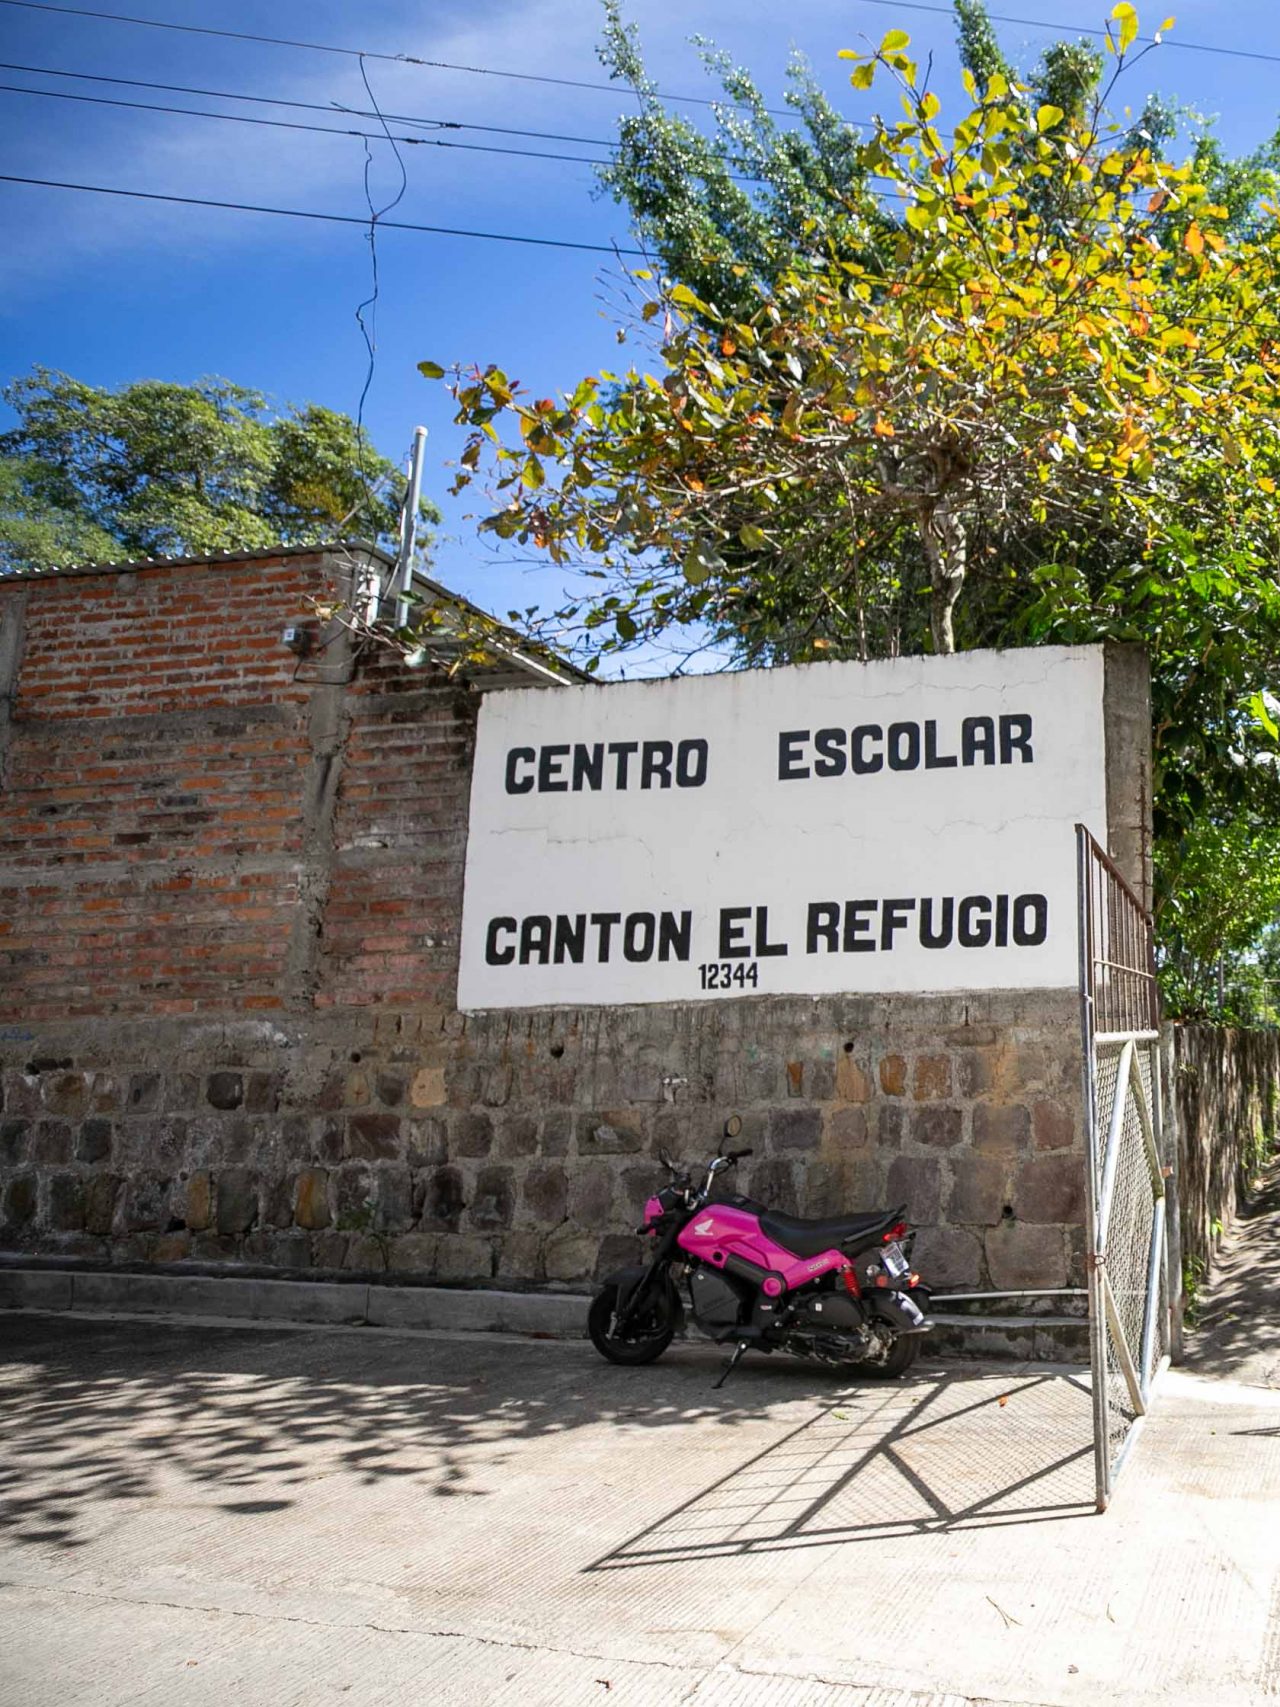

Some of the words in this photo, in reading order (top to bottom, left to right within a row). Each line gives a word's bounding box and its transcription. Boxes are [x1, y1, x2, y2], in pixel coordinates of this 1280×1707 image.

[505, 738, 709, 795] CENTRO
[778, 713, 1034, 781] ESCOLAR
[485, 910, 692, 966] CANTON
[718, 906, 788, 959] EL
[806, 893, 1048, 954] REFUGIO
[698, 962, 758, 990] 12344
